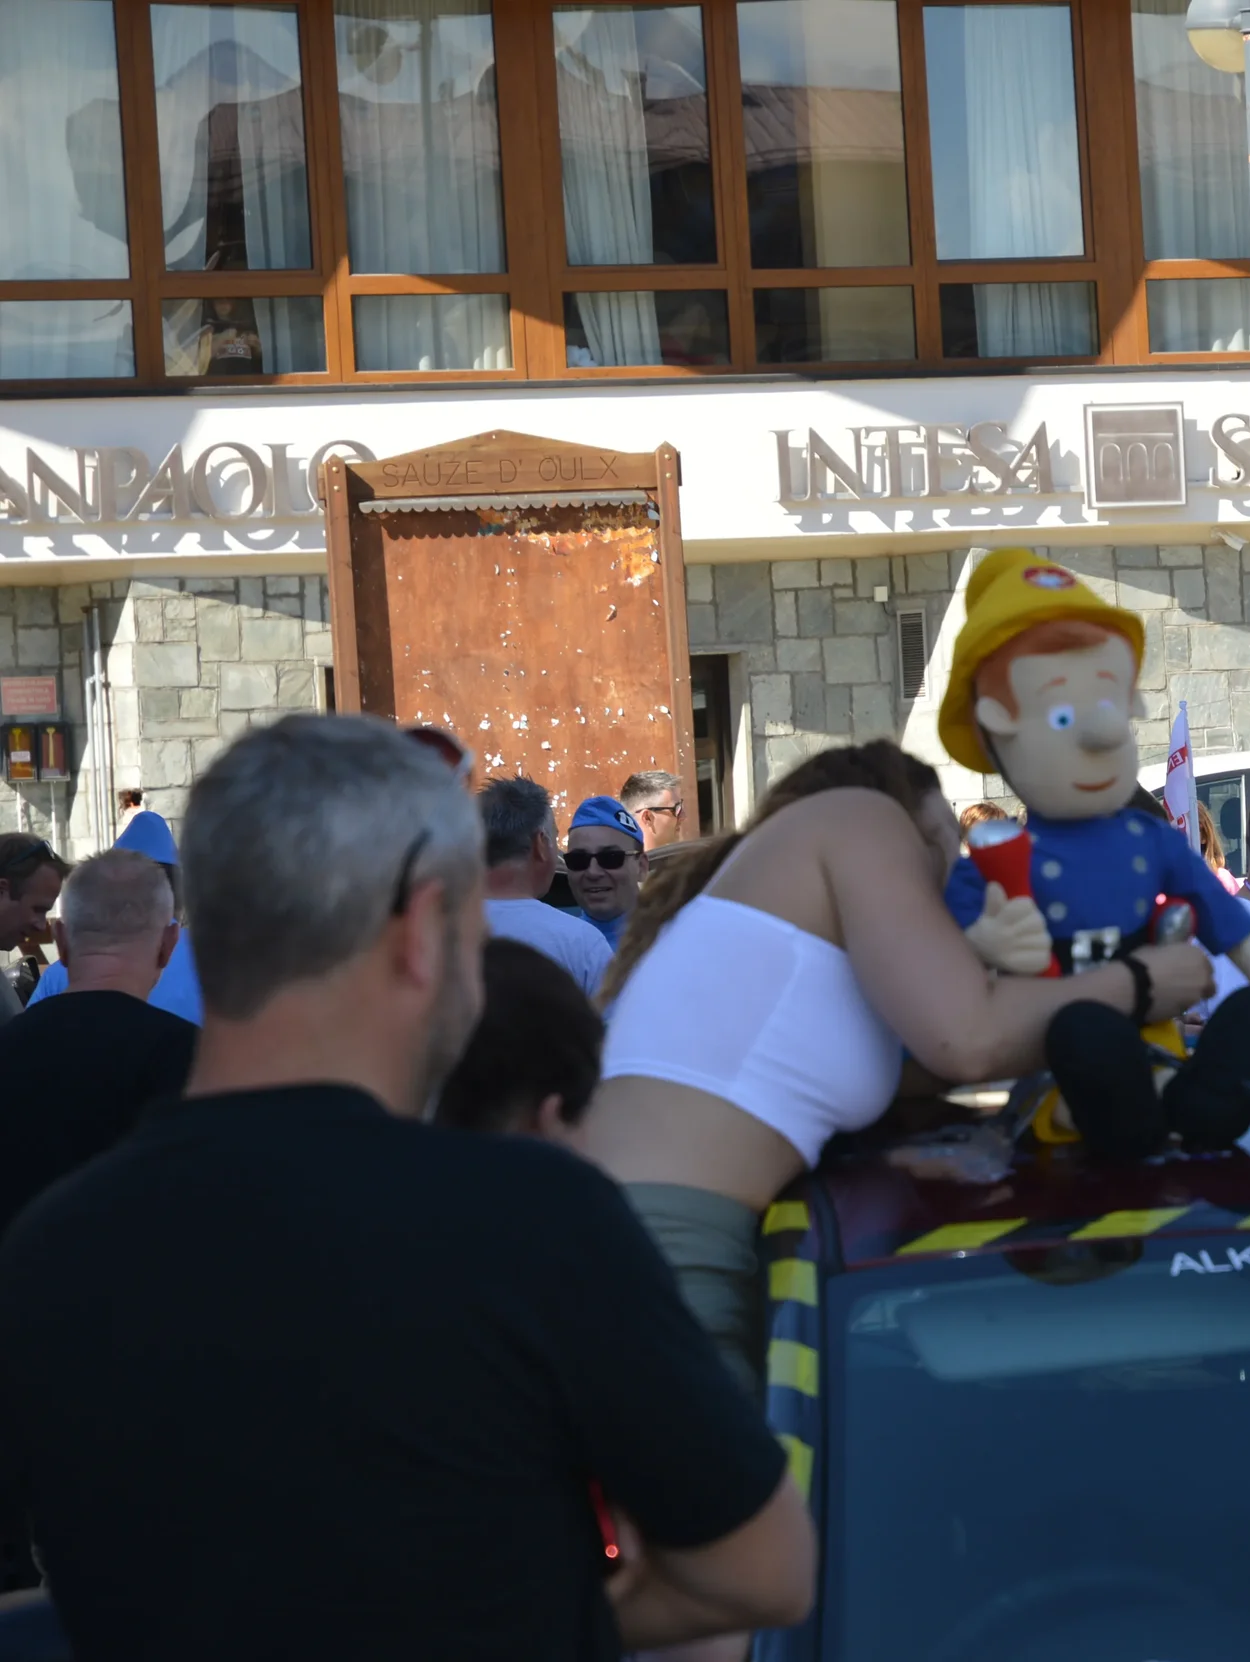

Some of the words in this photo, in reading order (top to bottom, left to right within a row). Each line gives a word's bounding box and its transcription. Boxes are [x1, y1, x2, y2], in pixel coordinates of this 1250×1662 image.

[381, 460, 484, 488] SAUZE
[538, 455, 619, 482] OULX
[769, 420, 1054, 502] INTESA
